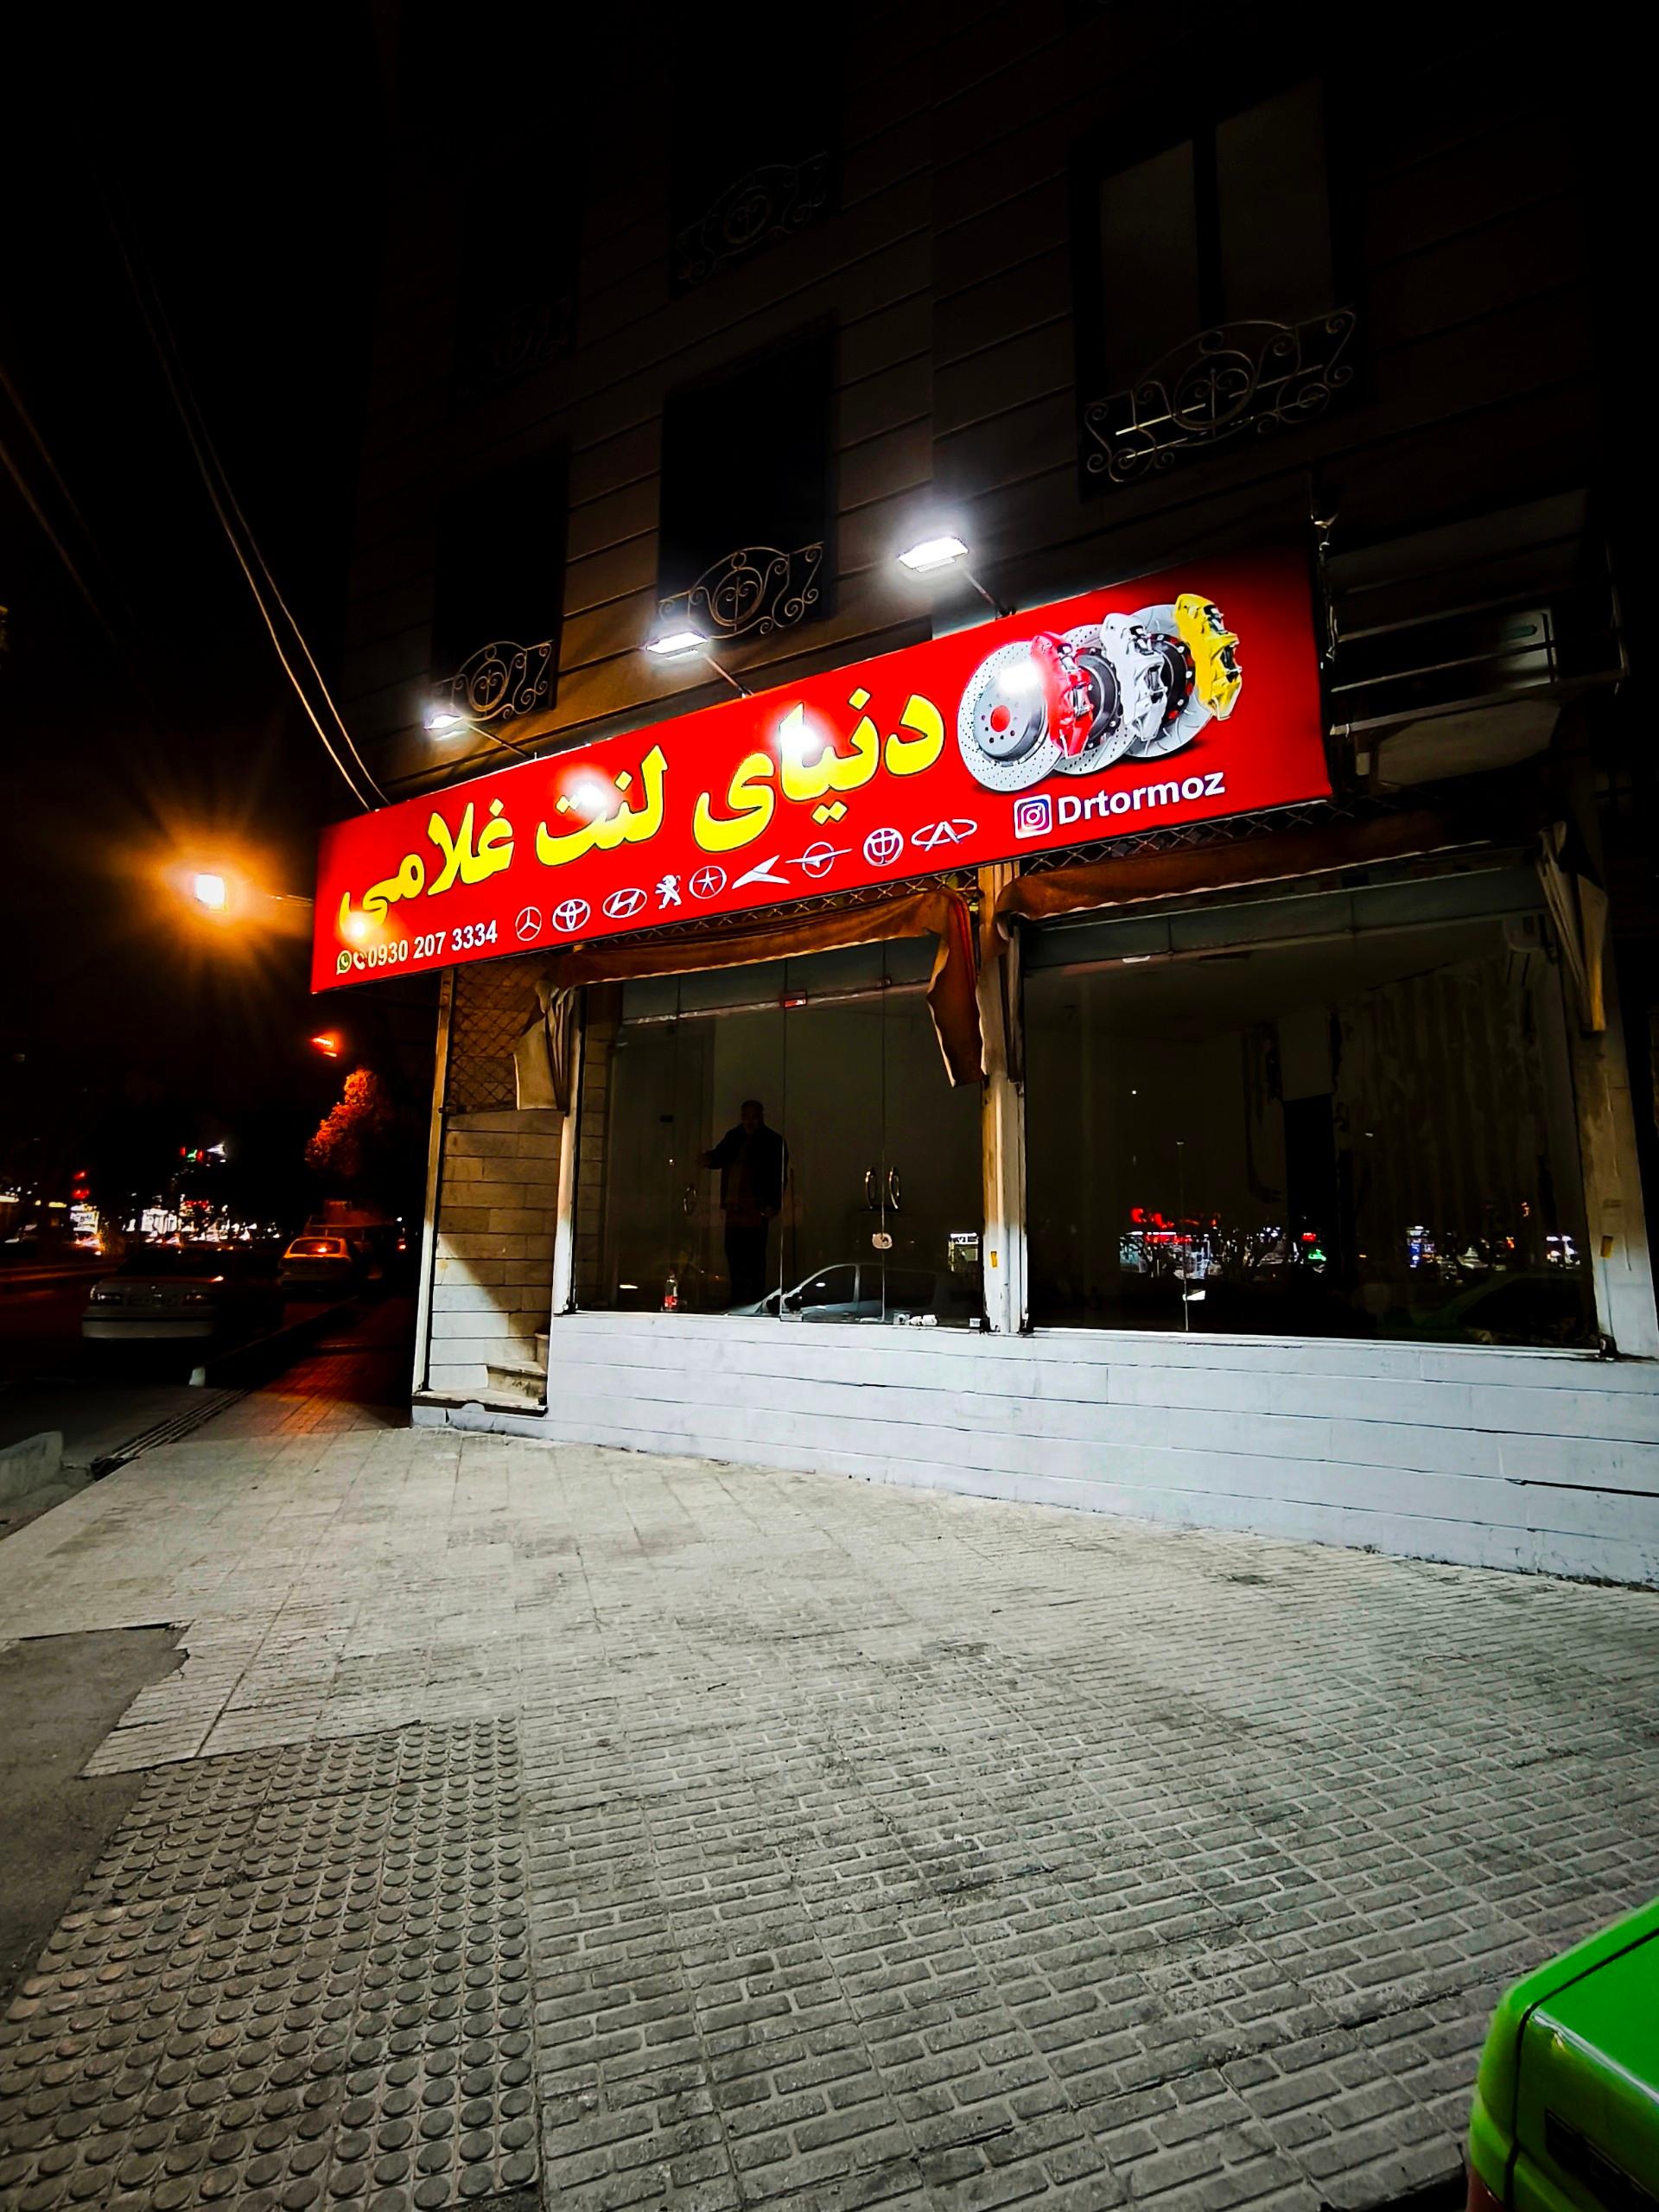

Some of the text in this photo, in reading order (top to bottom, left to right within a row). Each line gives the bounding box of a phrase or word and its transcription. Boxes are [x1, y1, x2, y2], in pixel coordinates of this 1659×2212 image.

[340, 687, 945, 937] دنیای لنت غلامی
[1058, 772, 1225, 825] Drtormoz
[367, 919, 499, 969] 0930 207 3334
